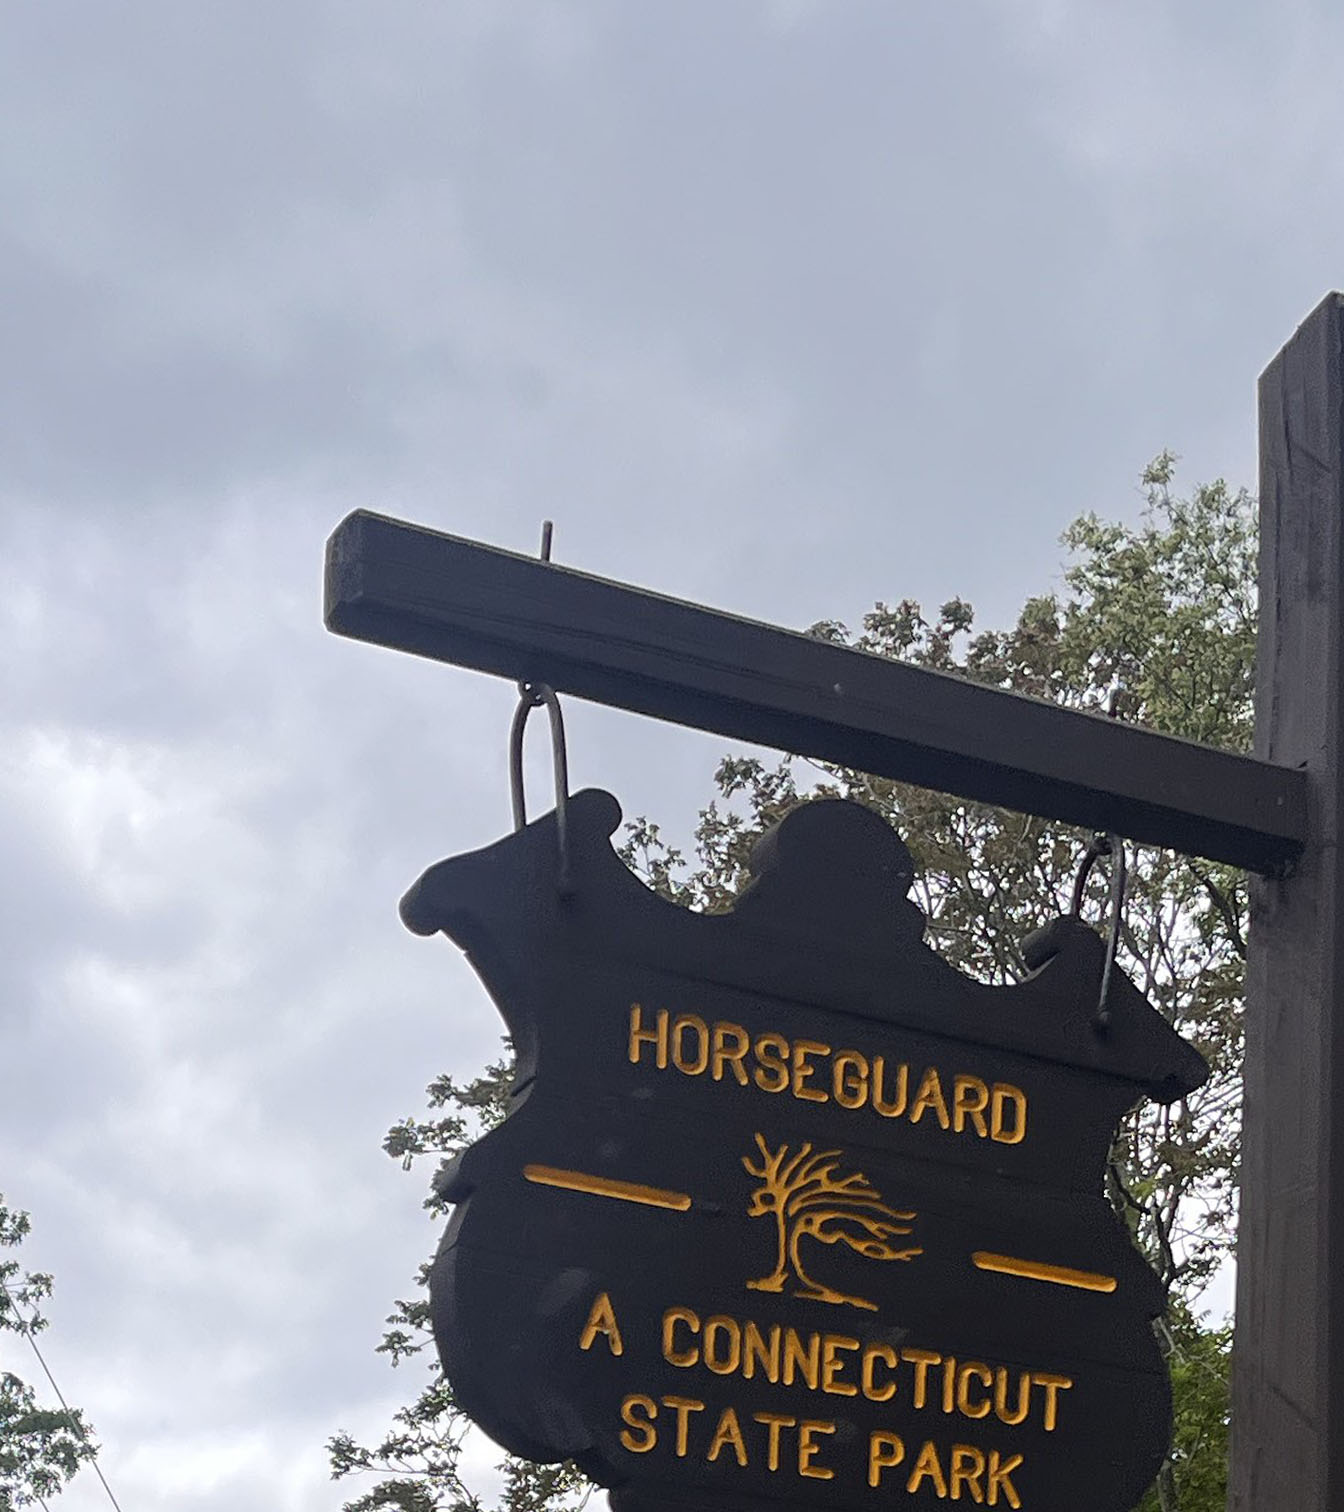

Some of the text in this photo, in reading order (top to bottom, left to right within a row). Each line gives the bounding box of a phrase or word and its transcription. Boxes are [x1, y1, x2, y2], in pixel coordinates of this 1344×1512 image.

[628, 1004, 1028, 1145] HORSEGUARD
[580, 1292, 1072, 1432] A CONNECTICUT
[619, 1394, 1024, 1510] STATE PARK
